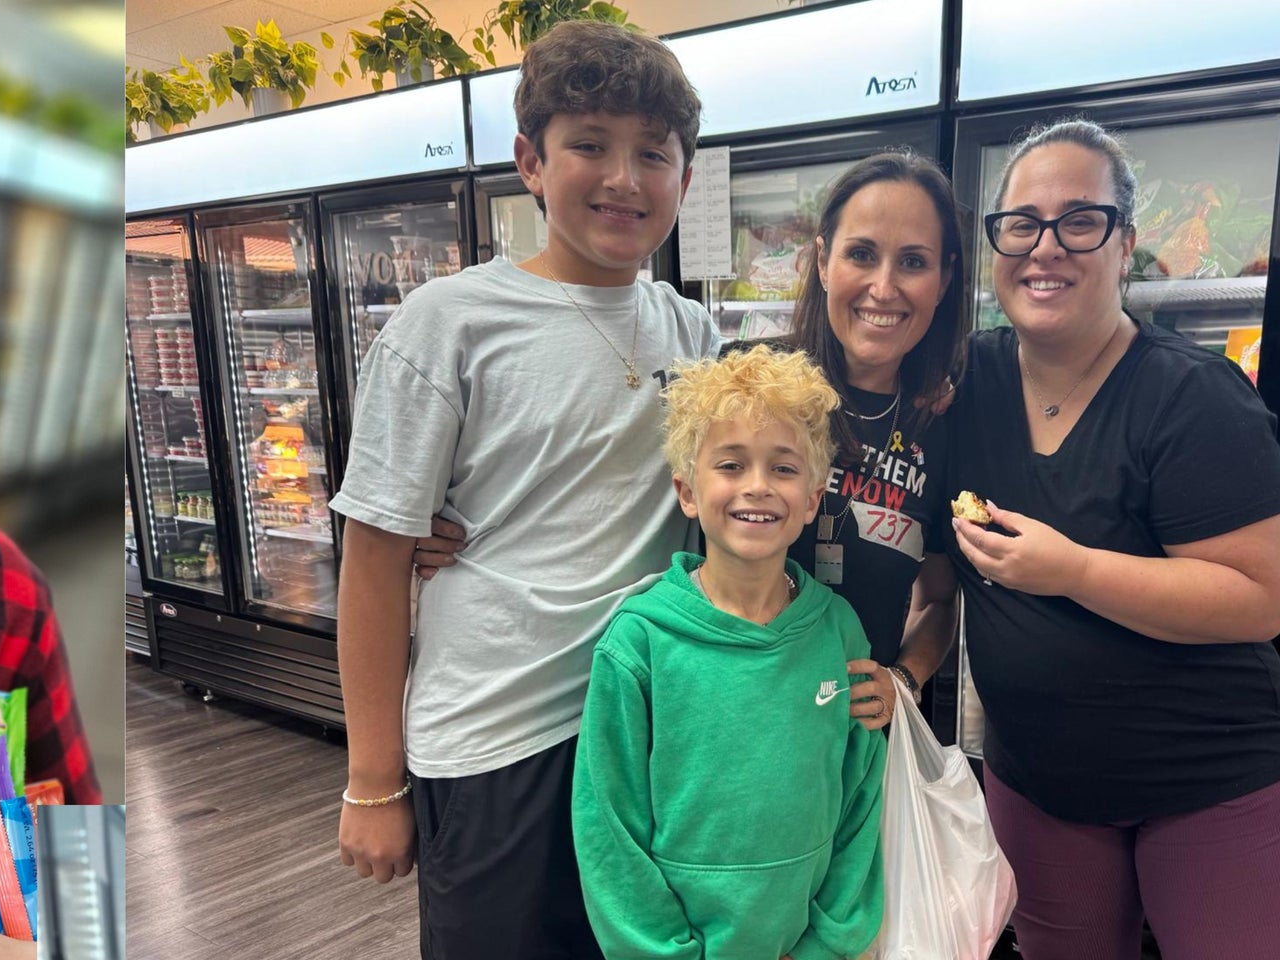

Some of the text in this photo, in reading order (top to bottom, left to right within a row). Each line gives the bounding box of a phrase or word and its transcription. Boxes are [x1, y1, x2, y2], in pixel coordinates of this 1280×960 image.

[861, 443, 927, 498] THEM
[842, 471, 907, 512] NOW
[867, 510, 913, 546] 737
[819, 680, 838, 696] NIKE
